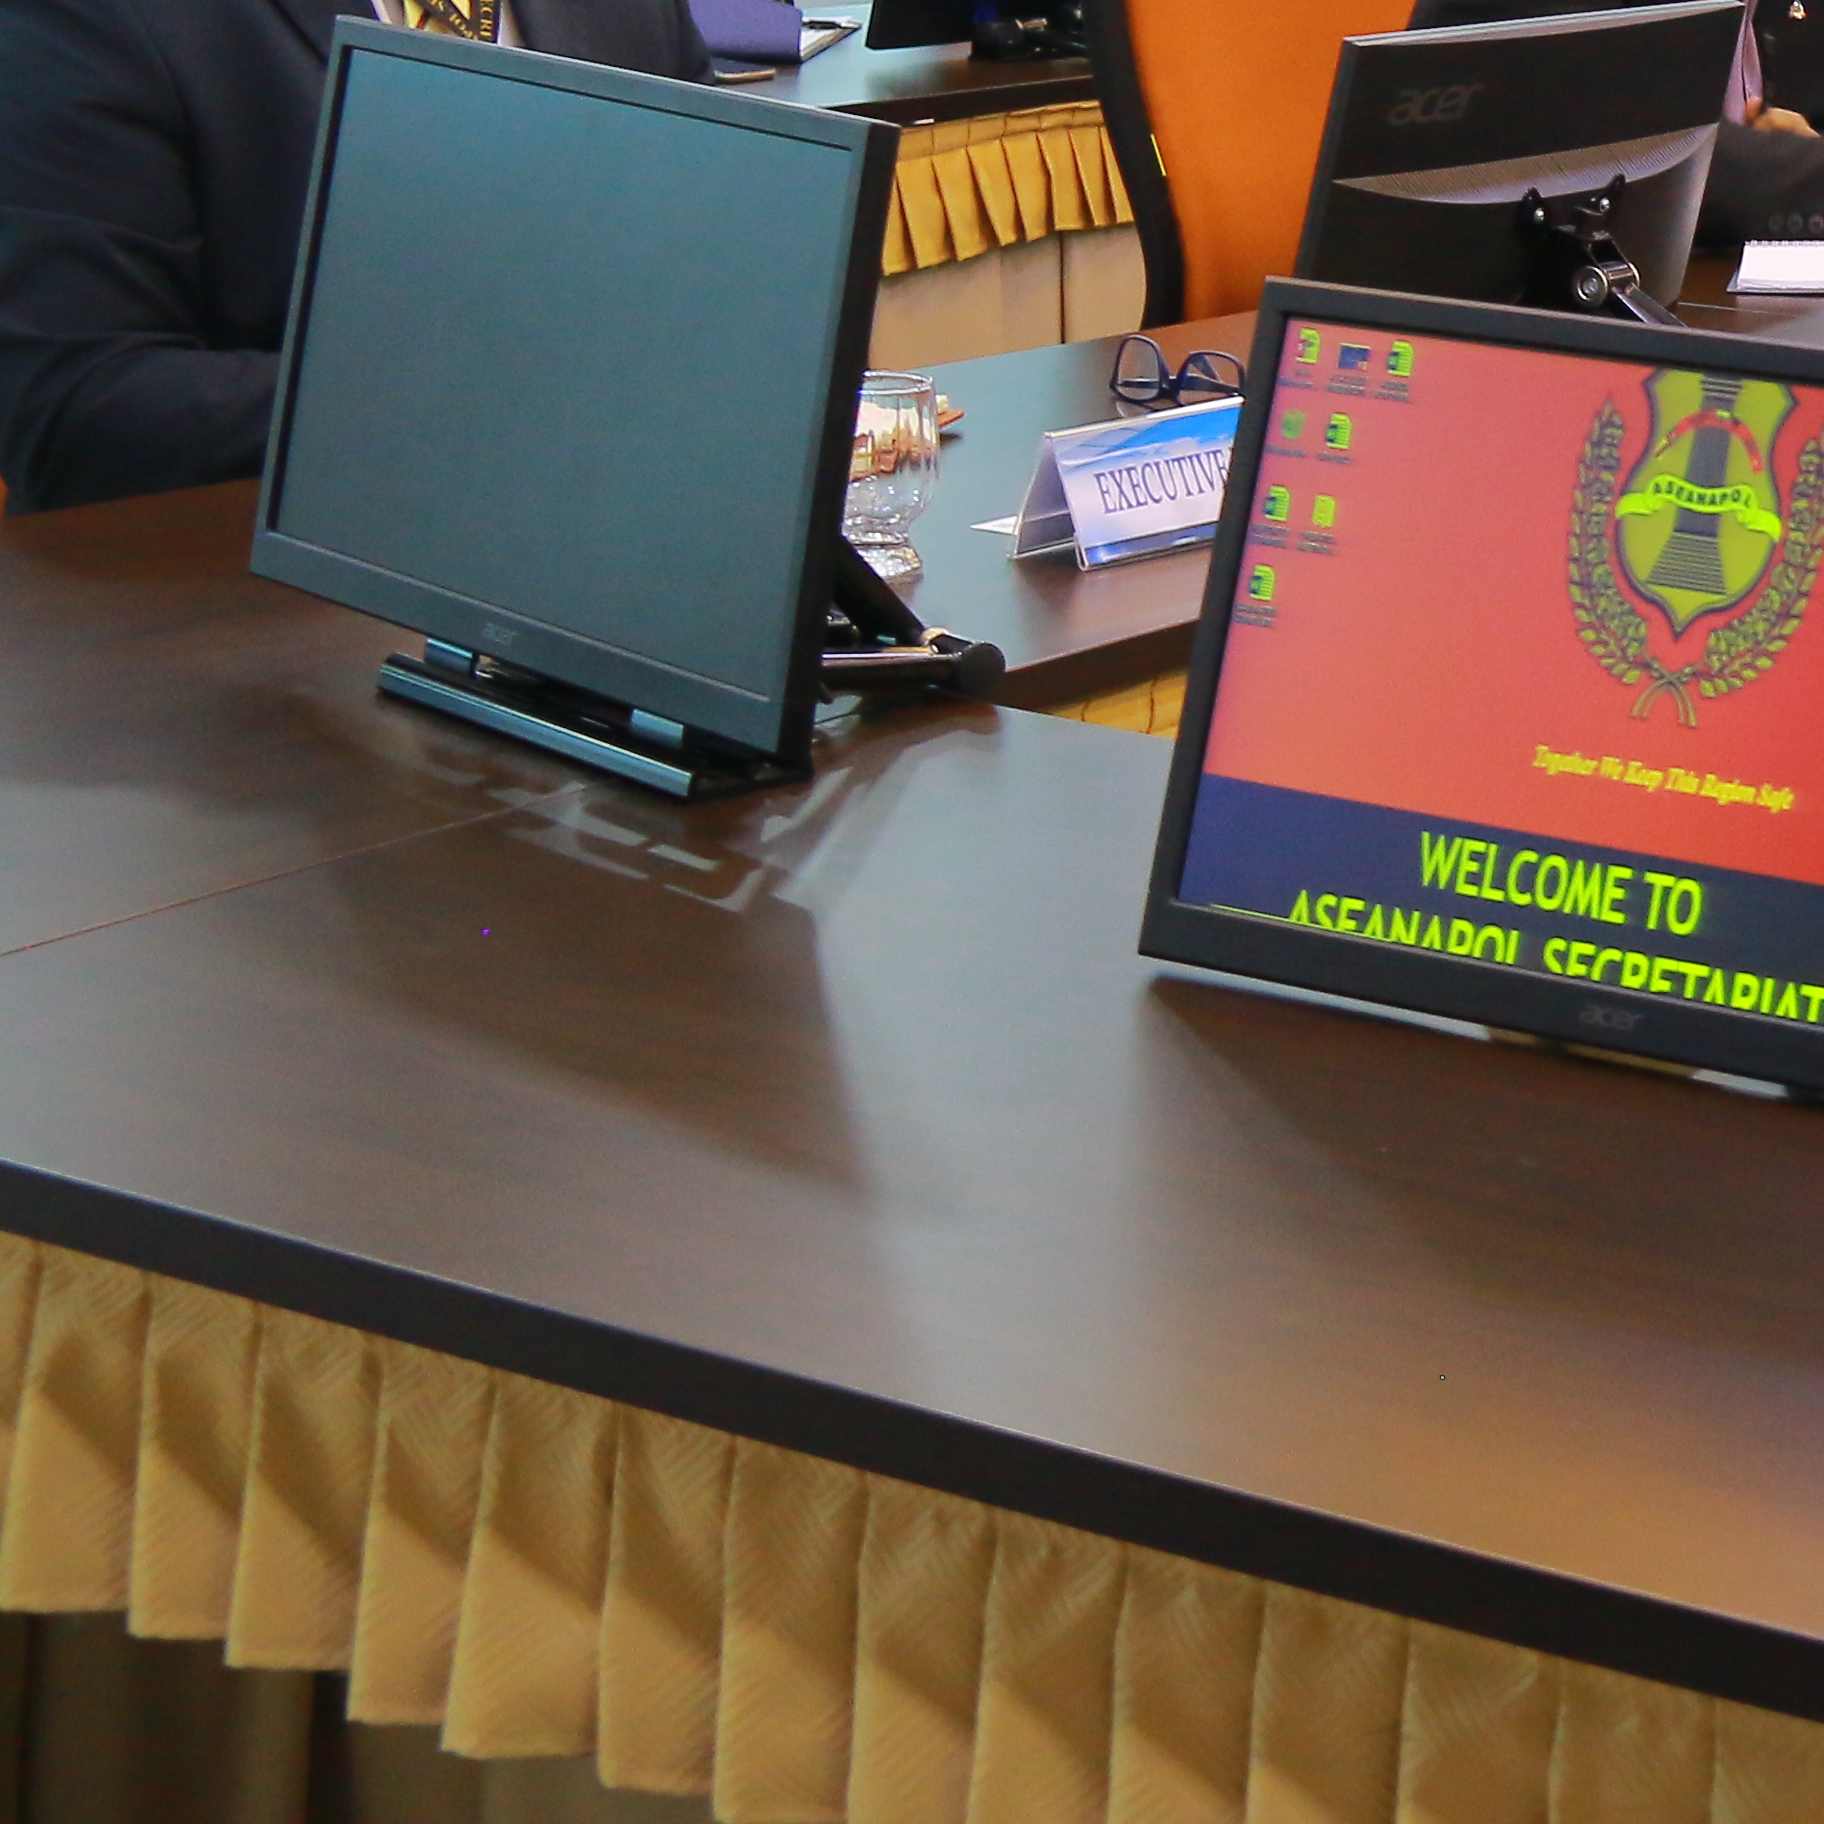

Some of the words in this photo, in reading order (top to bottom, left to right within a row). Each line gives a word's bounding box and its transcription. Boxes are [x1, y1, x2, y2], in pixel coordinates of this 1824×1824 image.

[1387, 84, 1482, 125] acer
[1093, 448, 1230, 514] EXECUTIVE
[1652, 481, 1751, 507] ASEANAPOL
[481, 622, 519, 646] acer
[1533, 744, 1598, 776] Together
[1601, 756, 1624, 781] We
[1623, 760, 1664, 793] Keep
[1665, 767, 1701, 794] This
[1700, 773, 1757, 806] Region
[1757, 782, 1795, 814] Safe
[1419, 830, 1635, 925] WELCOME
[1644, 869, 1703, 936] TO
[1287, 889, 1521, 966] ASEANAPOL
[1578, 1003, 1647, 1032] acer
